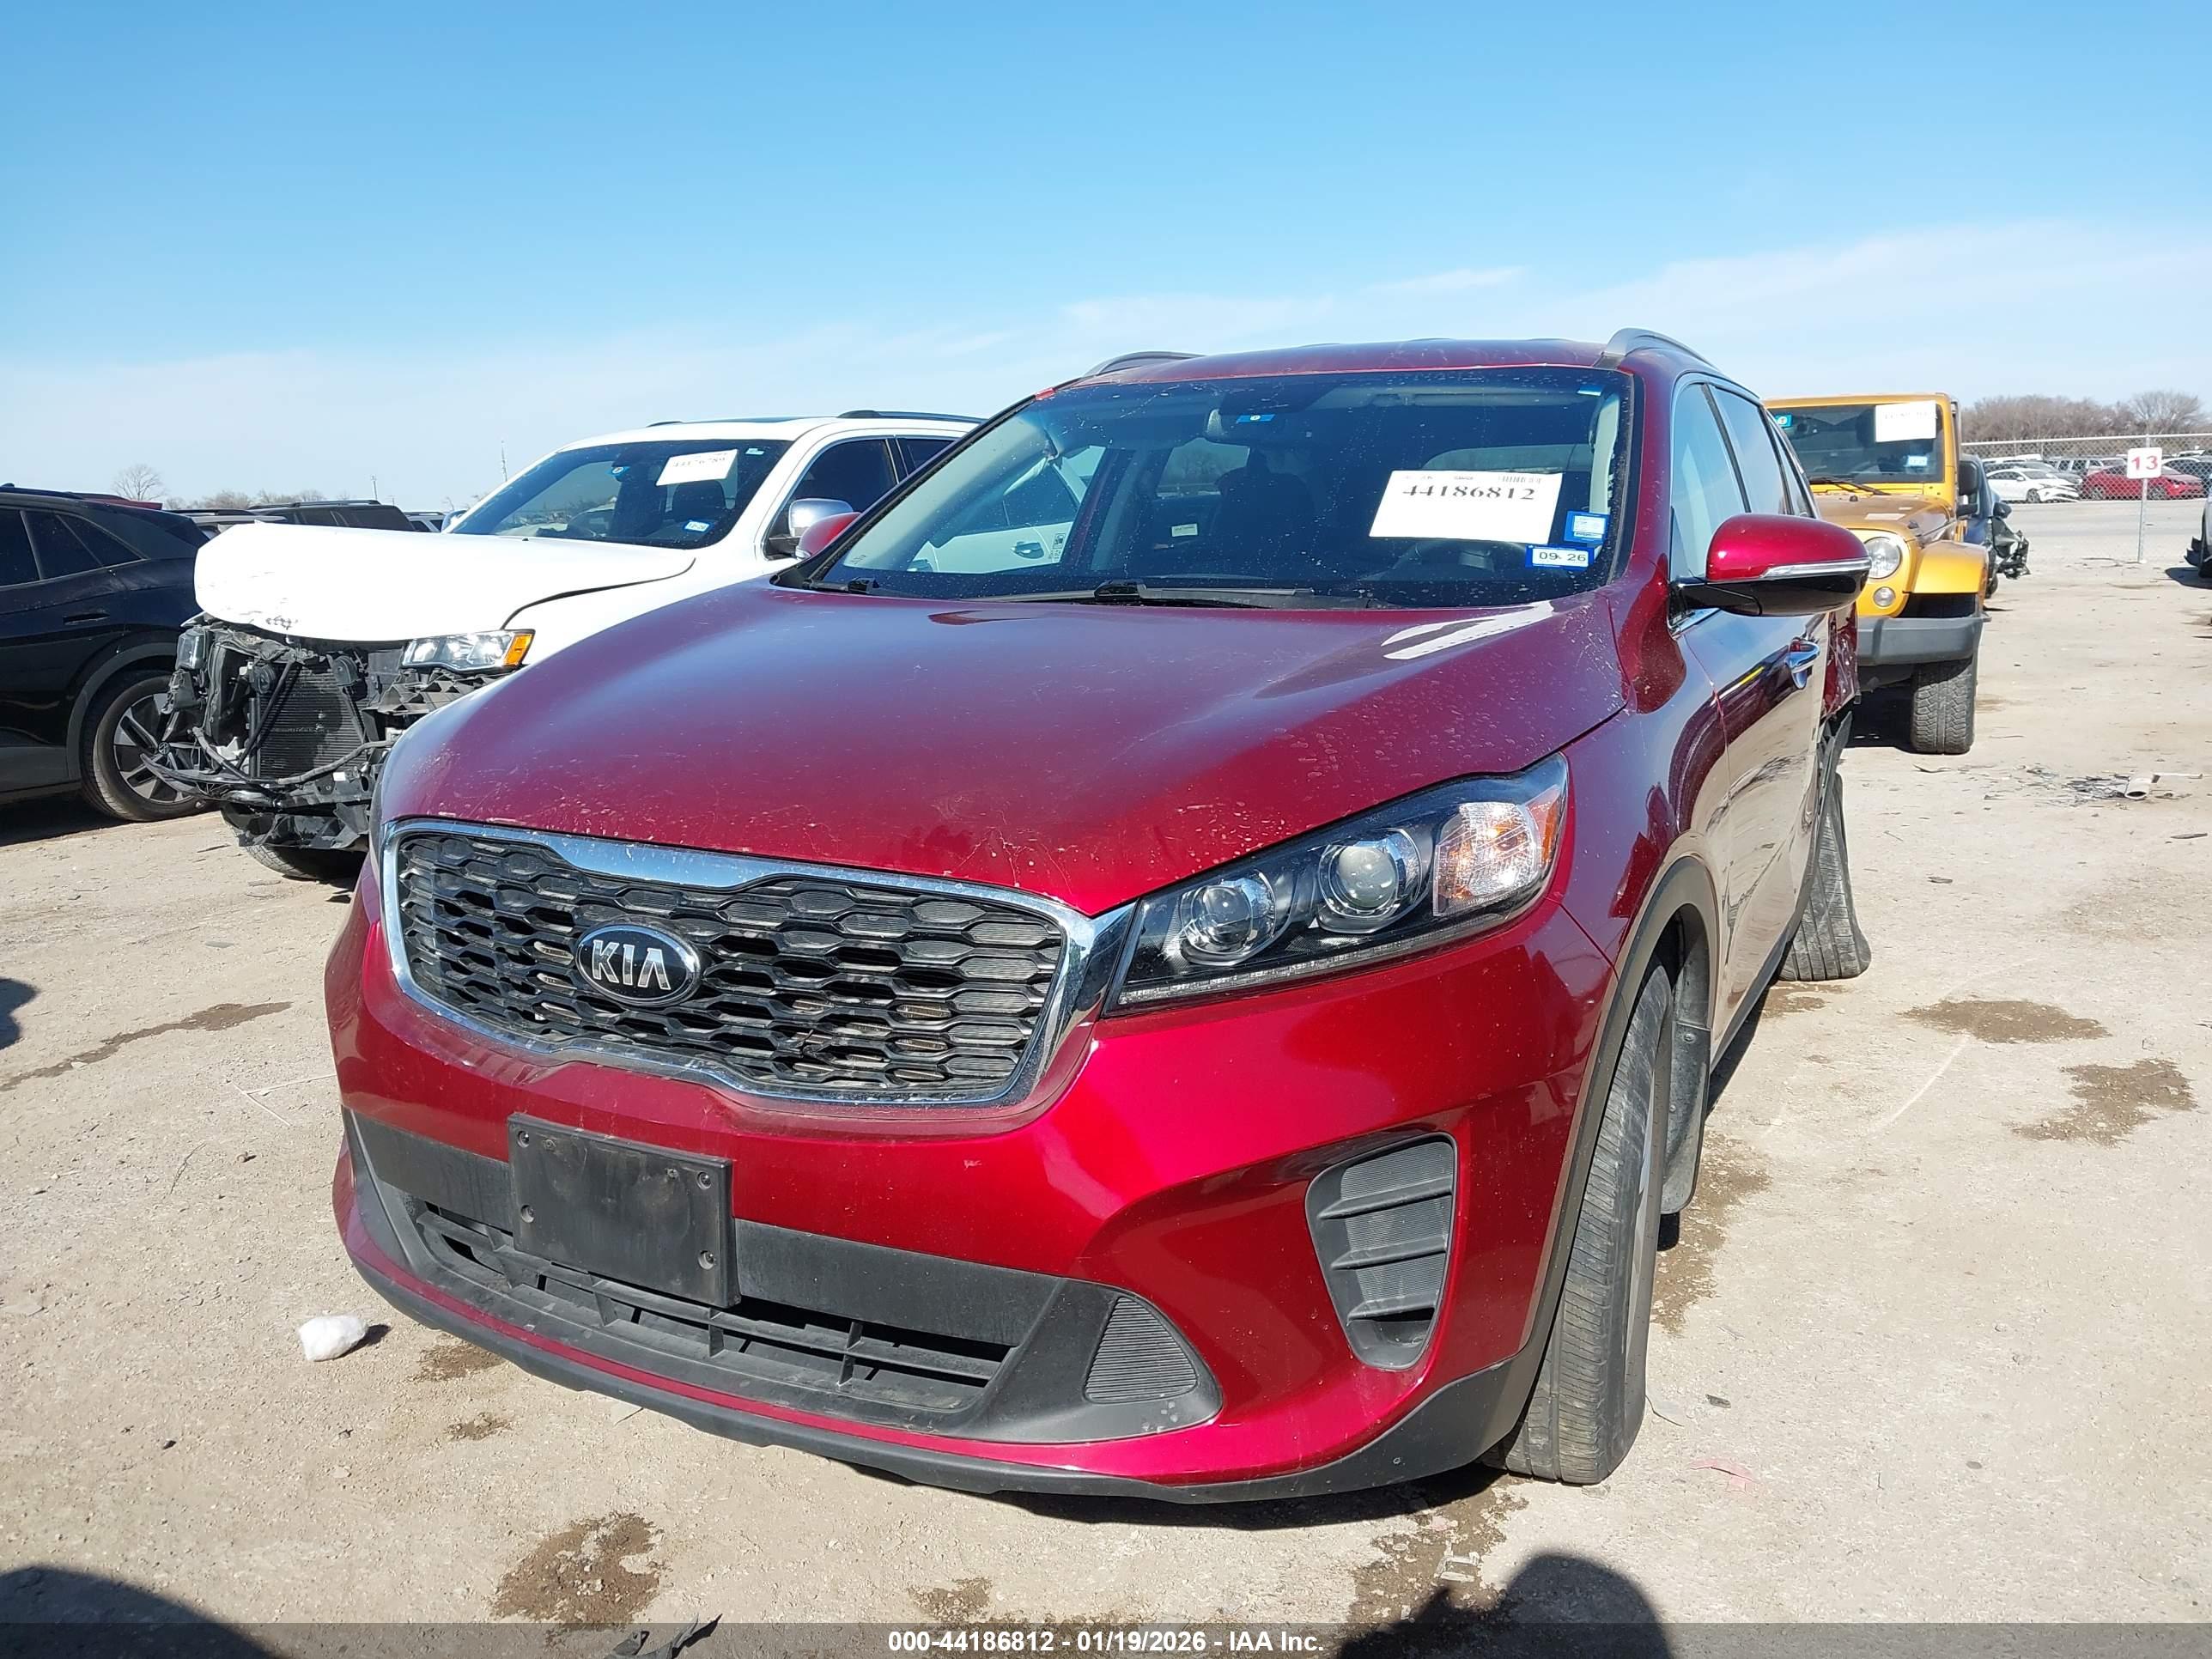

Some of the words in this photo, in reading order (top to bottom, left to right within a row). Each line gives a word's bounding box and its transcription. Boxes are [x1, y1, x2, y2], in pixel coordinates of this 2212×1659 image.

[2131, 455, 2158, 471] 13
[1402, 485, 1535, 501] 44186812
[592, 939, 672, 990] KIA
